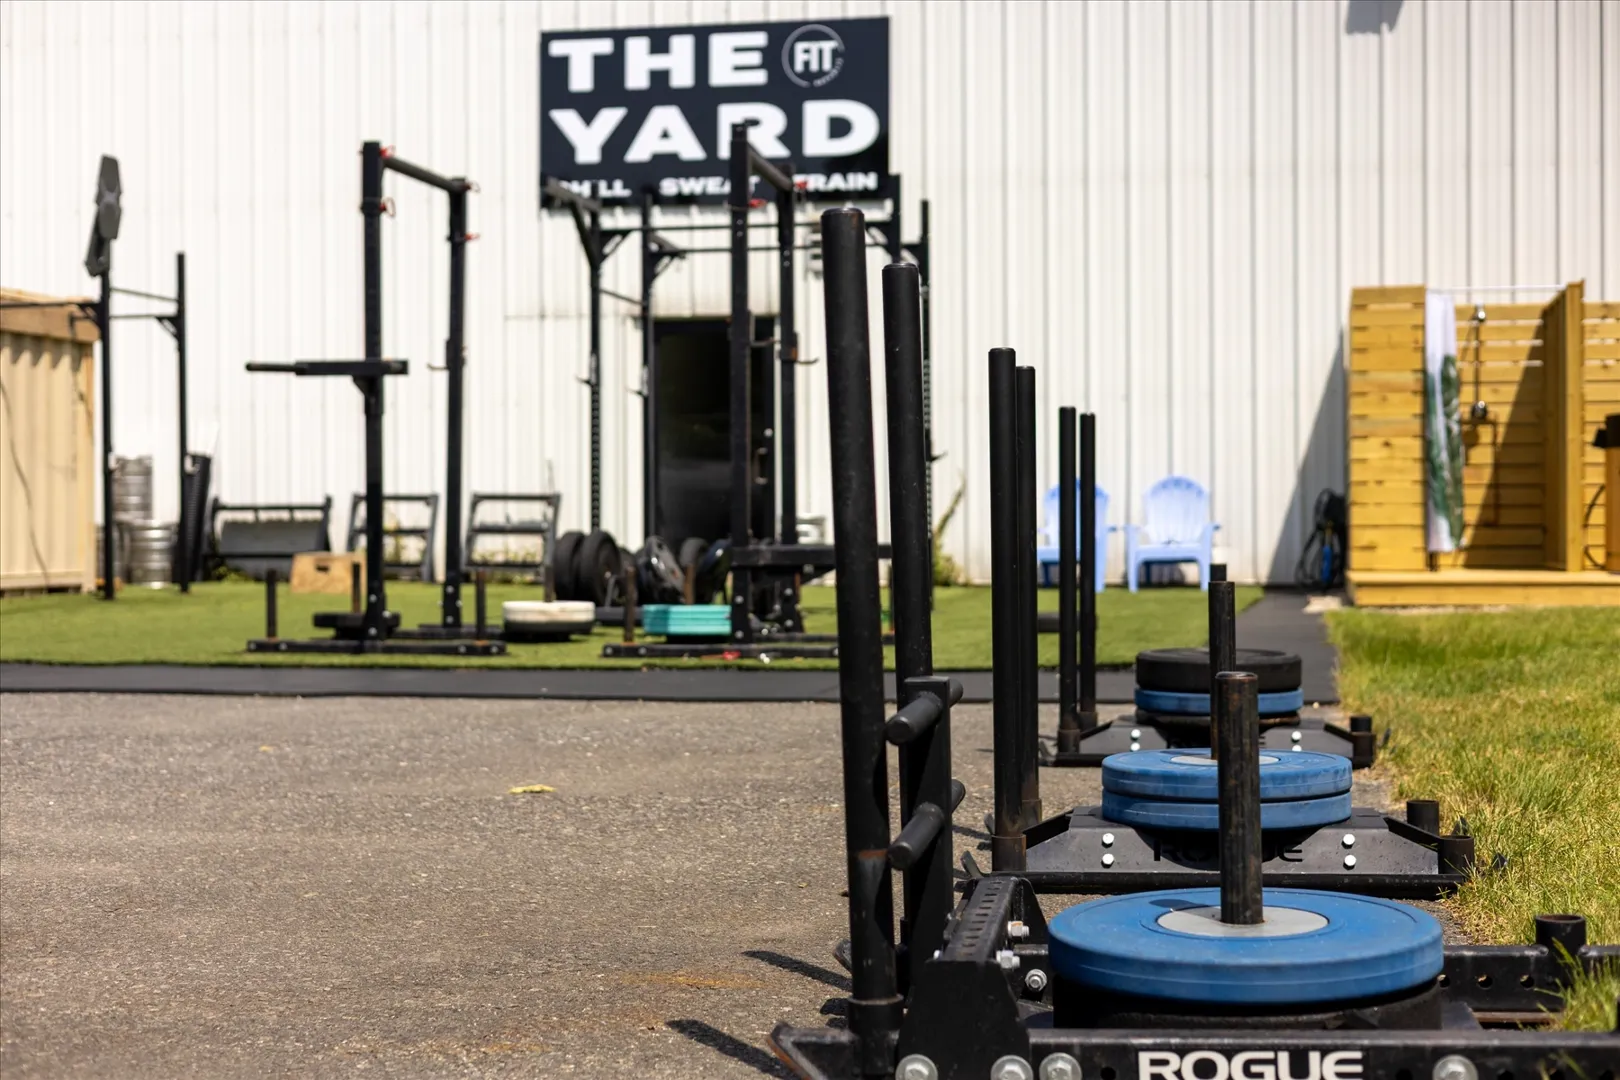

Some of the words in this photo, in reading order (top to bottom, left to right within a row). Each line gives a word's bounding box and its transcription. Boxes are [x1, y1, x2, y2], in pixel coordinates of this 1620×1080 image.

[548, 31, 769, 93] THE
[794, 40, 839, 73] FIT
[548, 99, 880, 165] YARD
[557, 179, 633, 199] HLL
[1138, 1050, 1364, 1080] ROGUE
